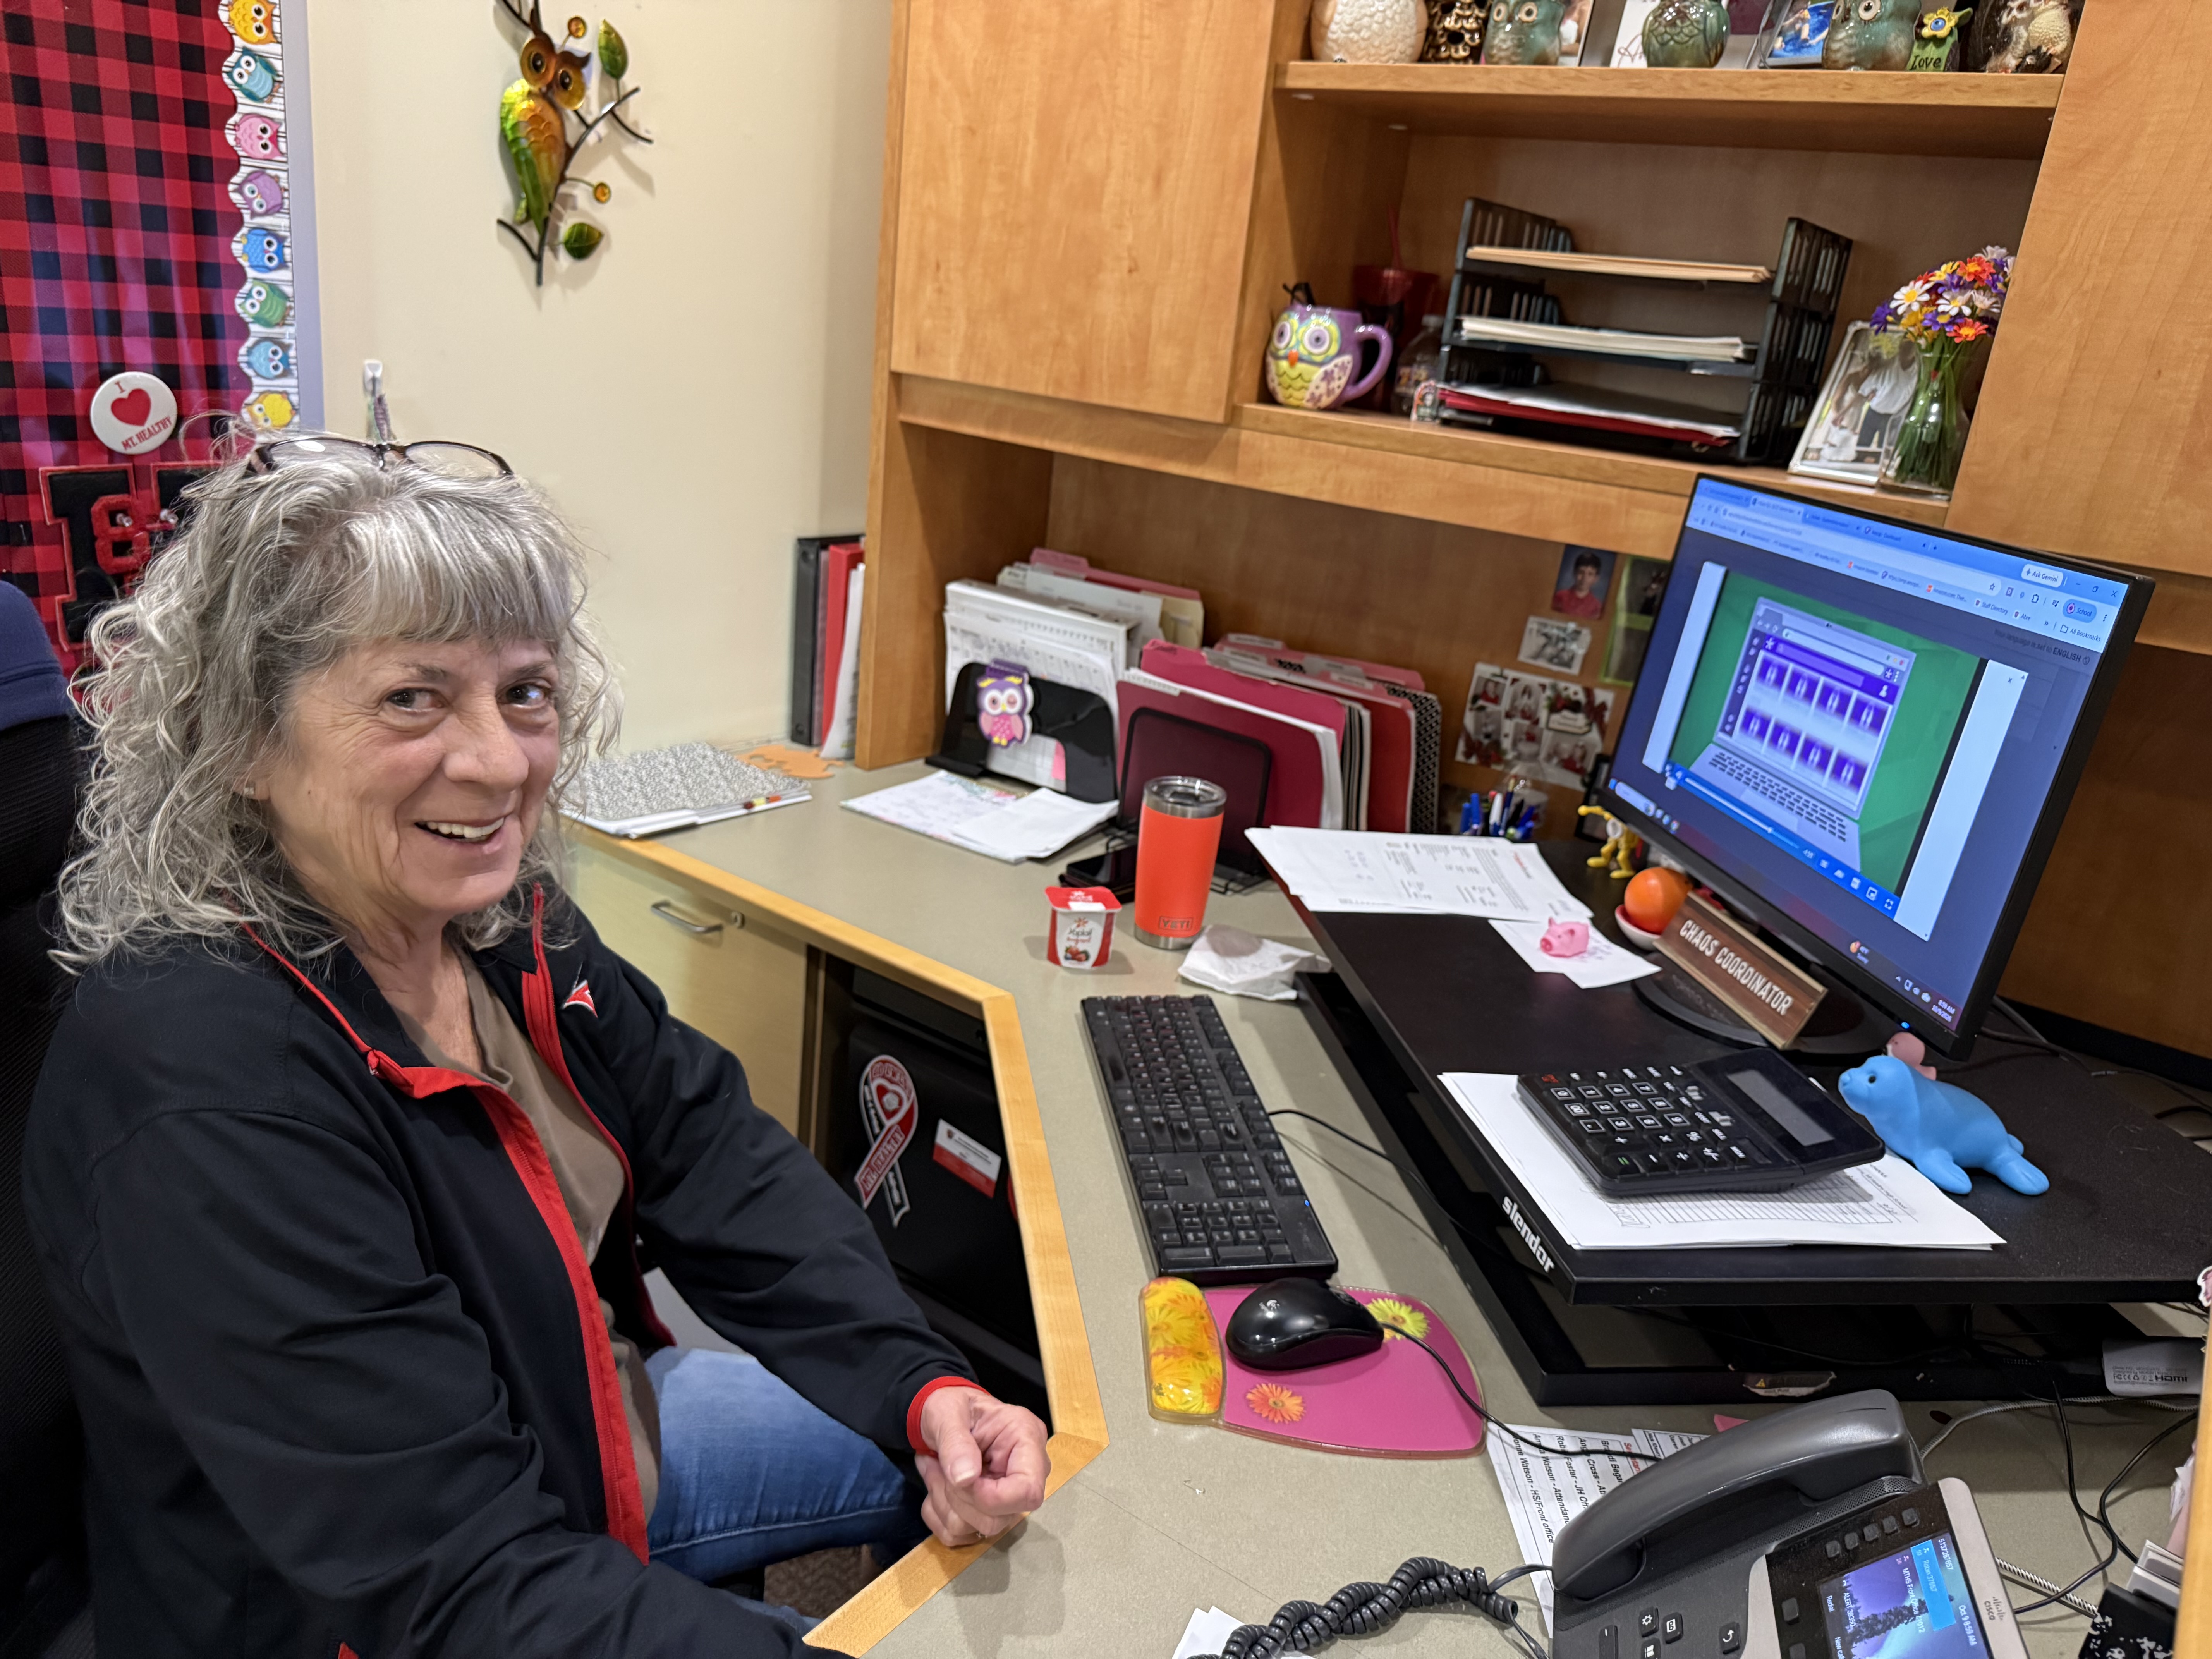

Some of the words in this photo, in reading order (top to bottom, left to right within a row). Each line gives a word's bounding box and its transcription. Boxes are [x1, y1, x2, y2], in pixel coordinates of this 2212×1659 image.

[1909, 55, 1941, 70] Love
[115, 381, 125, 393] I
[136, 416, 172, 443] HEALTHY
[2041, 573, 2058, 583] Gemini
[1990, 604, 2008, 615] Directory
[2076, 607, 2092, 617] School
[2076, 629, 2101, 642] Bookmarks
[2053, 647, 2081, 663] ENGLISH
[1680, 919, 1720, 957] CHAOS
[1714, 946, 1794, 1016] COORDINATOR
[1541, 1456, 1556, 1481] Watson
[1563, 1456, 1578, 1480] Foster
[1574, 1484, 1585, 1495] JH
[1587, 1458, 1600, 1480] Cross
[1520, 1457, 1534, 1483] Watson
[1531, 1490, 1548, 1522] HS/Front
[1542, 1522, 1554, 1544] office
[1902, 1568, 1912, 1585] MTHS
[1906, 1583, 1915, 1599] Front
[1826, 1595, 1835, 1612] Redial
[1844, 1592, 1853, 1608] ALERT
[1911, 1598, 1919, 1615] Office
[1958, 1605, 1967, 1616] Oct
[1968, 1635, 1977, 1646] AM
